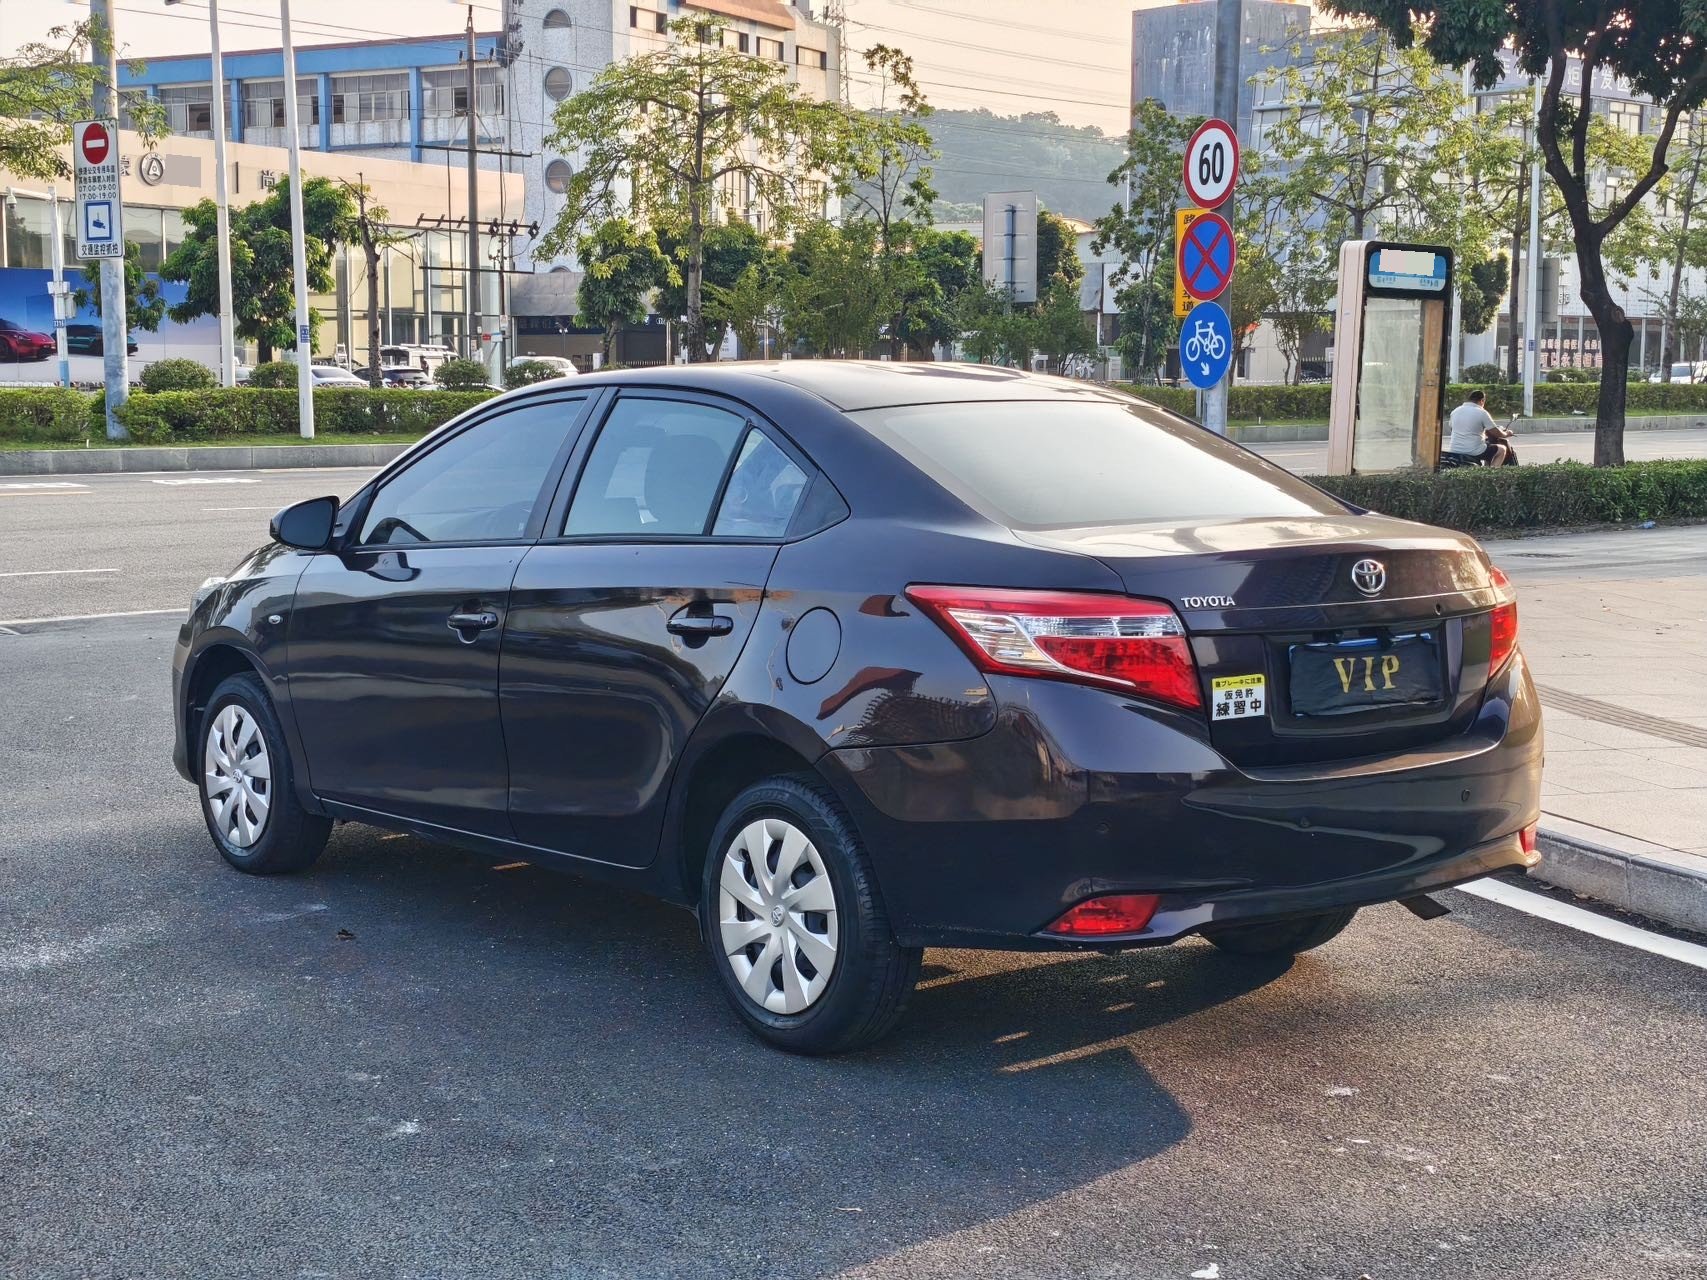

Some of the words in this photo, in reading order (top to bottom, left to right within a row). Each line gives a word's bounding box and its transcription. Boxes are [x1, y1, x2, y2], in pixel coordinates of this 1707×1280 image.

[1199, 141, 1224, 186] 60
[1181, 595, 1236, 609] TOYOTA
[1333, 654, 1400, 694] VIP
[1224, 688, 1254, 700] 仮免許
[1216, 698, 1262, 717] 練習中
